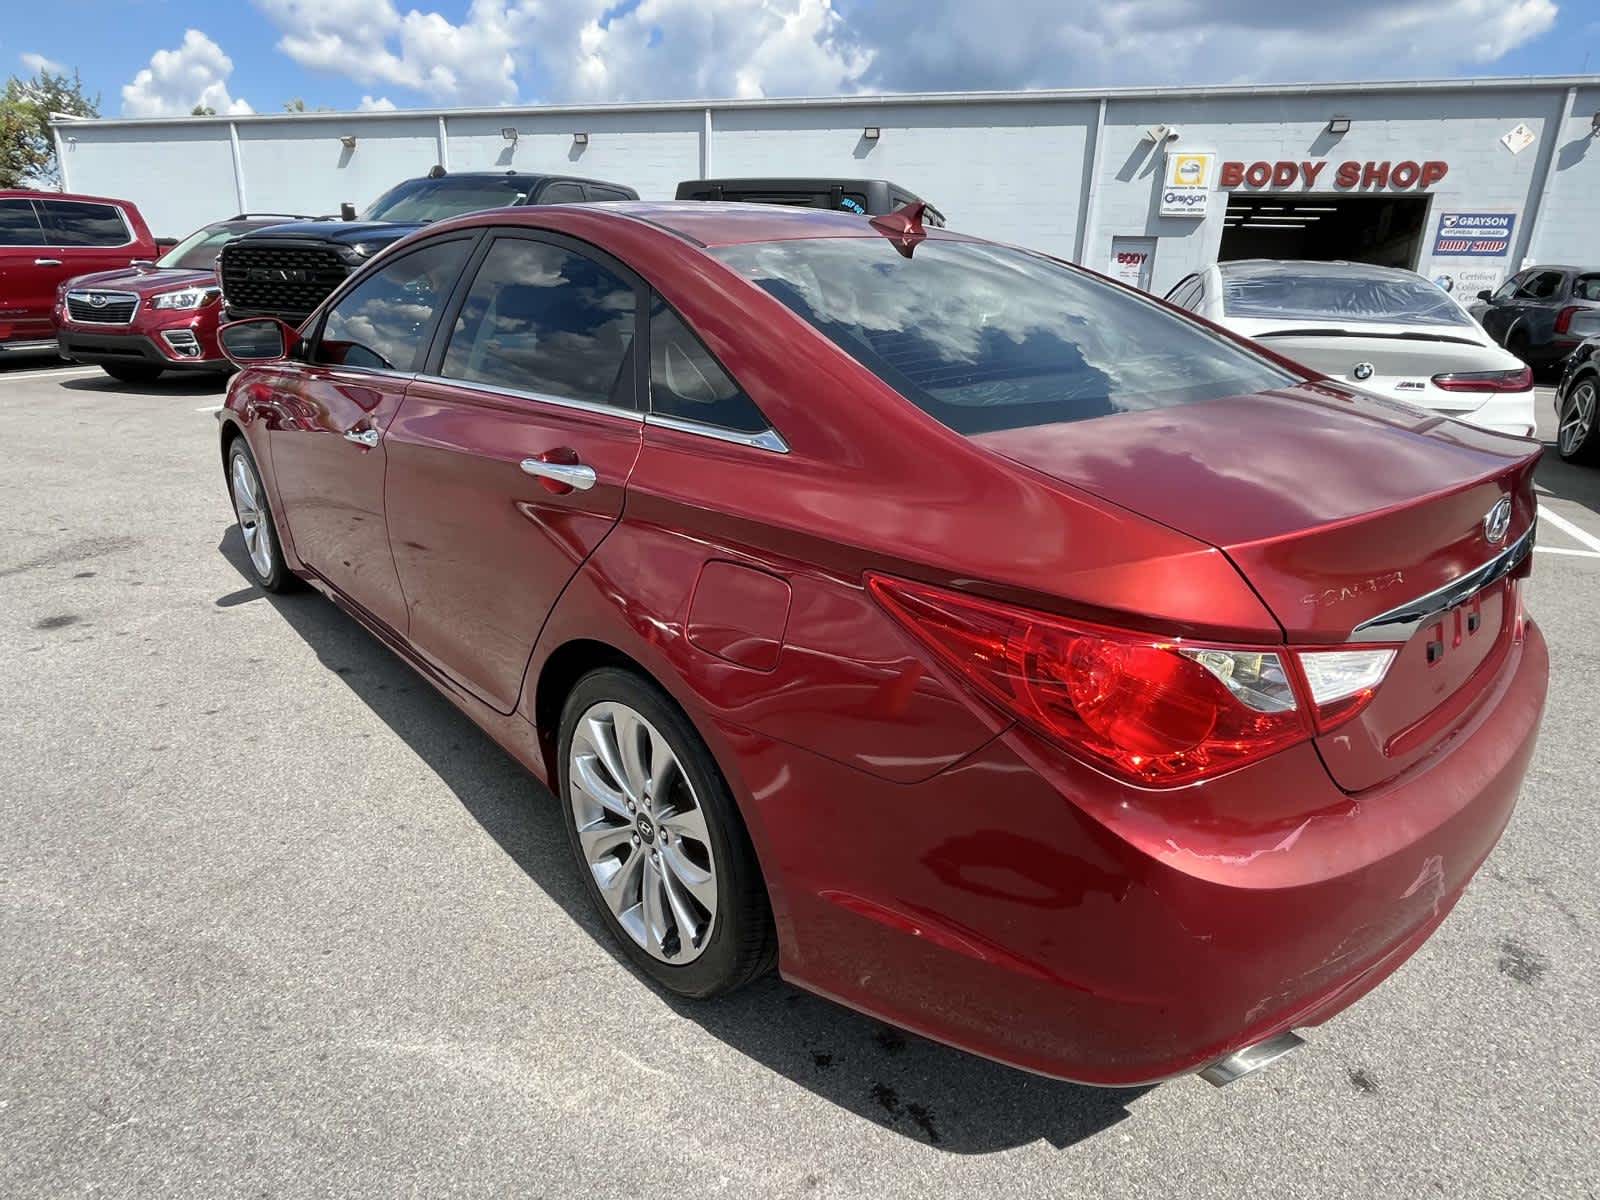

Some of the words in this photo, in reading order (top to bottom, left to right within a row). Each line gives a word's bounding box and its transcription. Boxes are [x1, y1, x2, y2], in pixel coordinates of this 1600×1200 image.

[1220, 161, 1327, 188] BODY
[1335, 160, 1449, 188] SHOP
[1164, 192, 1207, 206] Grayson
[1459, 216, 1508, 226] GRAYSON
[1437, 240, 1471, 252] BODY
[1472, 240, 1507, 253] SHOP
[1117, 252, 1148, 264] BODY
[1459, 271, 1497, 281] Certified
